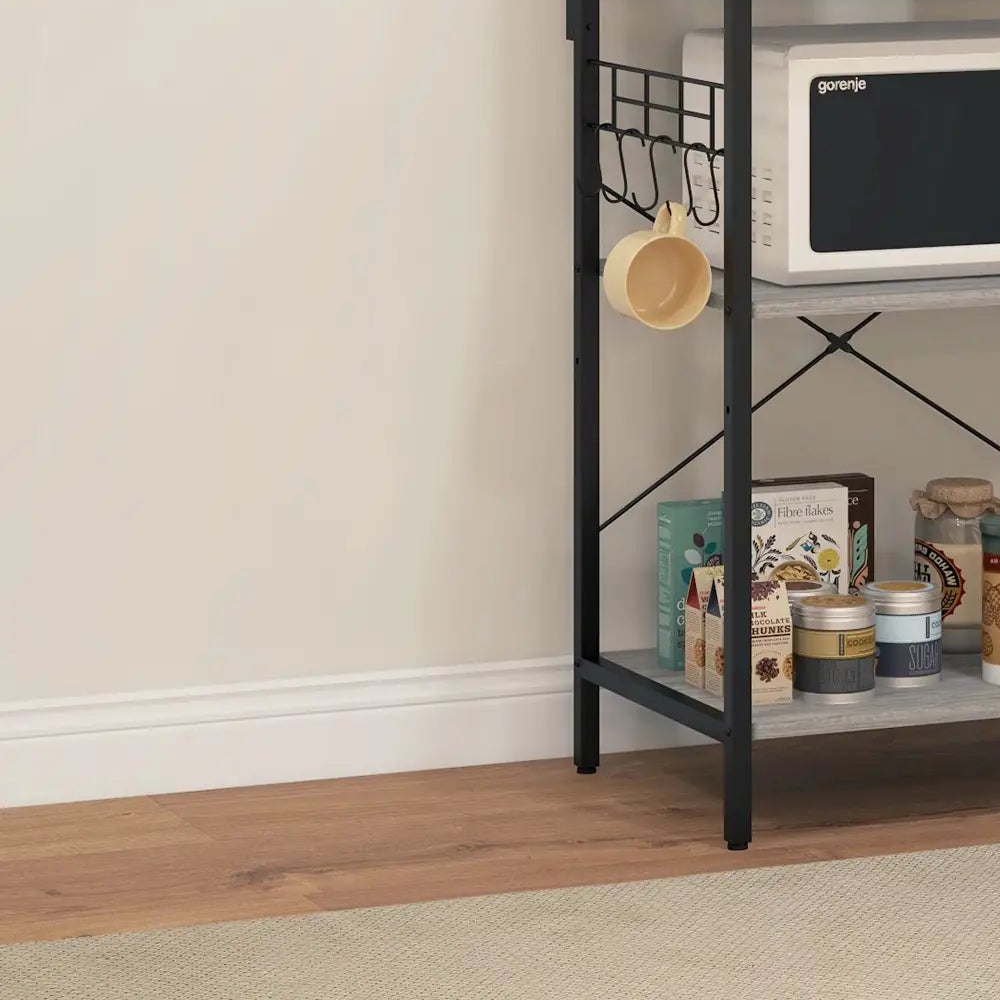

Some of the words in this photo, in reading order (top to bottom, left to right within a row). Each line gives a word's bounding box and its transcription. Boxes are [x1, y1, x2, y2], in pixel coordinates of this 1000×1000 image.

[818, 77, 867, 94] gorenje
[777, 506, 803, 518] Fibre
[805, 503, 834, 517] flakes
[752, 625, 791, 635] HUNKS
